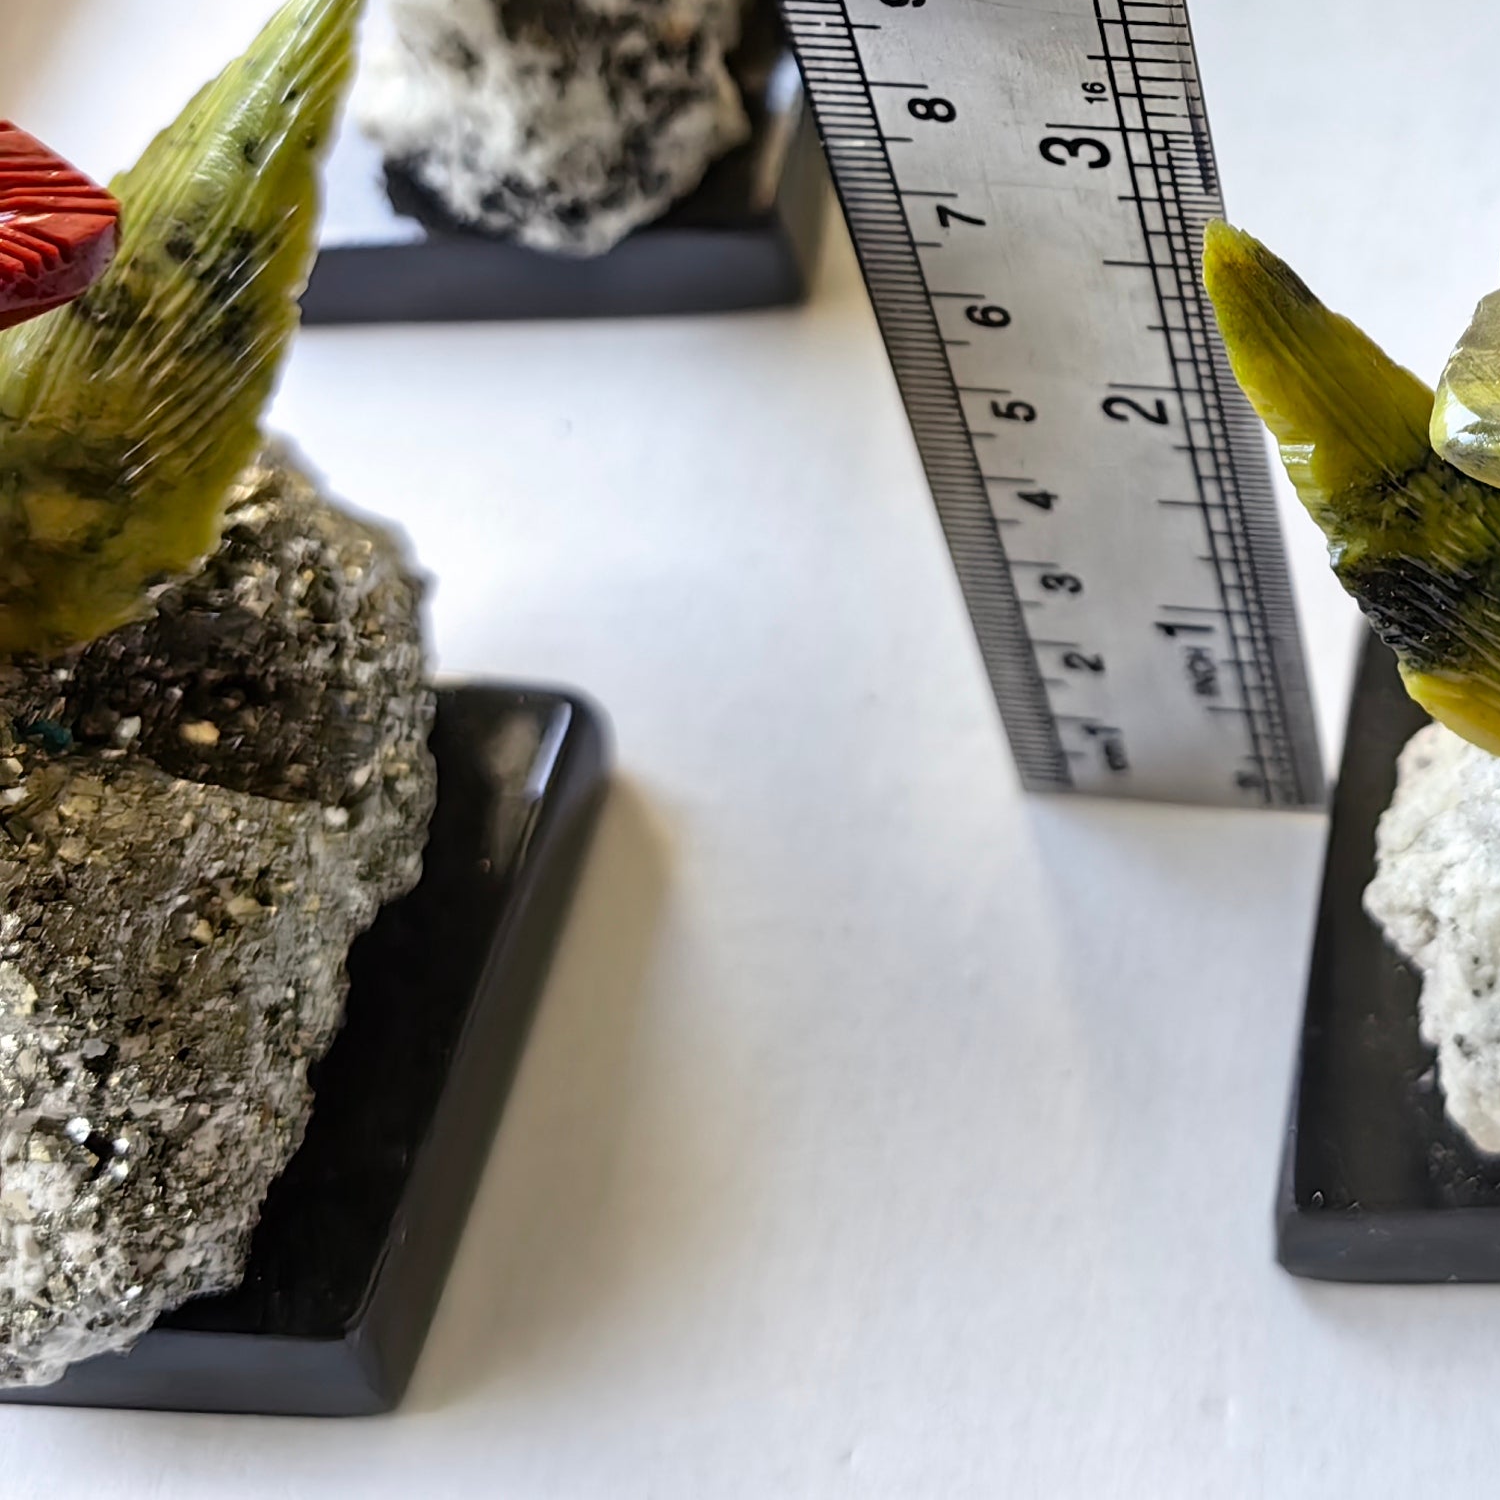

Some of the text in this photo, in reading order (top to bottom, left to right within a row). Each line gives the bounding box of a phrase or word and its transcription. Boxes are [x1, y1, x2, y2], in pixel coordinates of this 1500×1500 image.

[1081, 81, 1107, 103] 16
[907, 97, 957, 123] 8
[1039, 137, 1111, 169] 3
[938, 204, 986, 229] 7
[966, 304, 1011, 329] 6
[993, 400, 1037, 423] 5
[1102, 396, 1169, 426] 2
[1016, 491, 1058, 511] 4
[1040, 573, 1083, 594] 3
[1155, 621, 1214, 637] 1
[1062, 652, 1105, 673] 2
